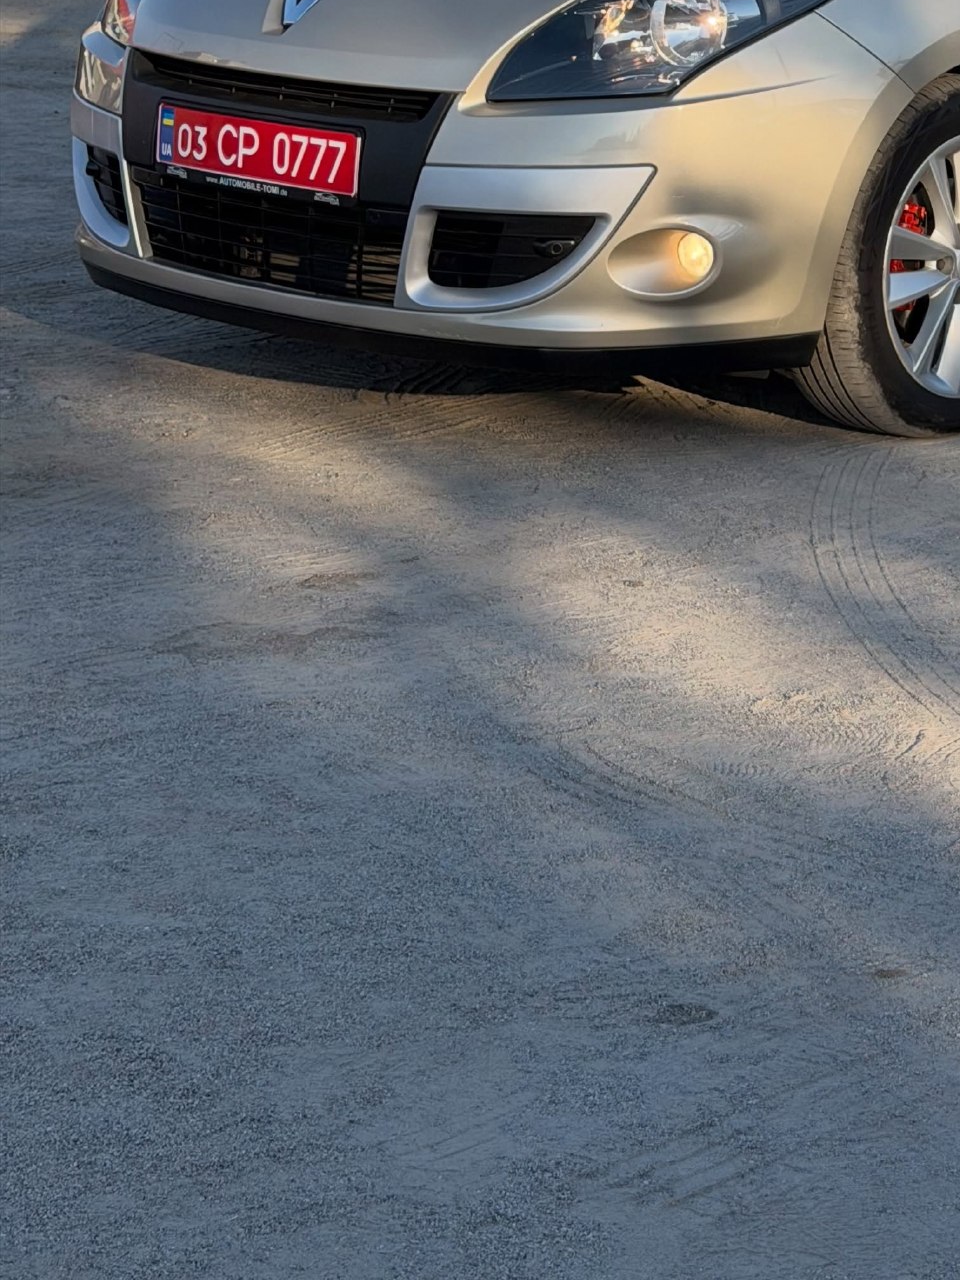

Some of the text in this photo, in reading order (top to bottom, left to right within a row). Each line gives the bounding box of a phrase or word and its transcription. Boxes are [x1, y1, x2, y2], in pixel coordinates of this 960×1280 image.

[161, 123, 347, 184] UA 03 CP 0777
